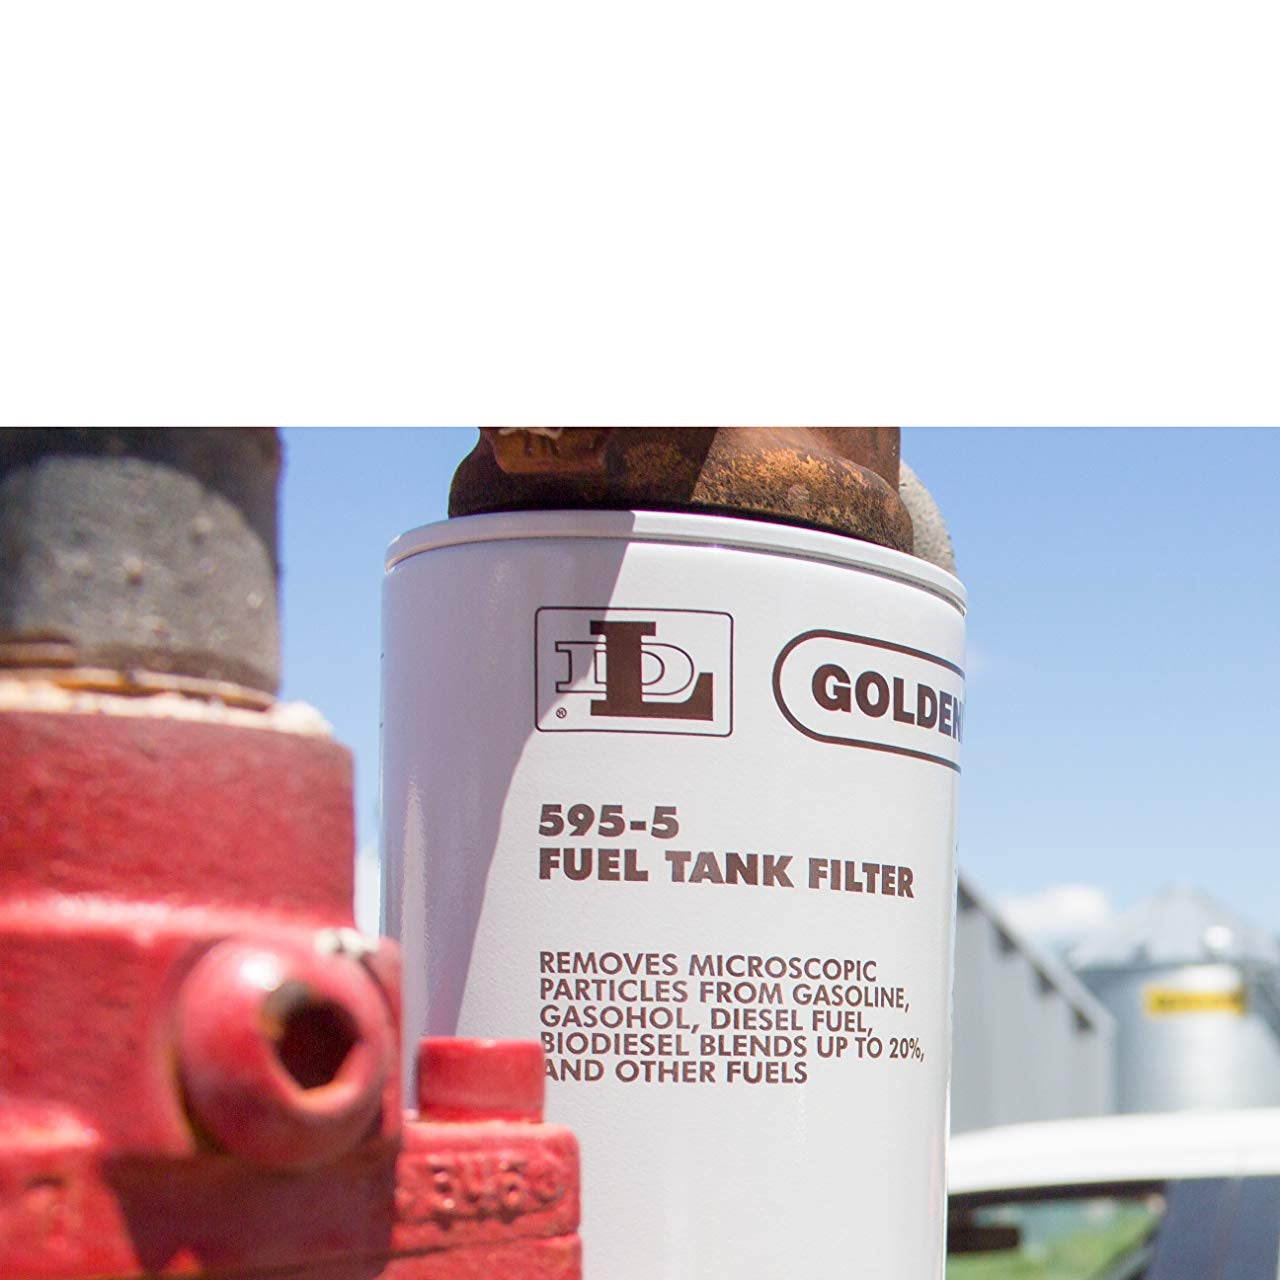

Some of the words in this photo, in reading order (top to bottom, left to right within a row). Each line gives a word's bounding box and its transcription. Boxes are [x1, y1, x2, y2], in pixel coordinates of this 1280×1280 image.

[538, 804, 680, 839] 595-5
[538, 847, 649, 882] FUEL
[665, 850, 794, 889] TANK
[808, 857, 915, 899] FILTER
[539, 951, 678, 976] REMOVES
[689, 954, 877, 982] MICROSCOPIC
[540, 978, 689, 1002] PARTICLES
[700, 981, 783, 1005] FROM
[792, 983, 910, 1013] GASOLINE,
[539, 1004, 700, 1034] GASOHOL,
[710, 1008, 804, 1031] DIESEL
[812, 1010, 873, 1037] FUEL,
[540, 1031, 690, 1056] BIODIESEL
[700, 1034, 808, 1058] BLENDS
[817, 1035, 848, 1058] UP
[855, 1036, 884, 1059] TO
[889, 1037, 925, 1063] 20%,
[544, 1058, 605, 1082] AND
[615, 1059, 717, 1083] OTHER
[726, 1060, 808, 1084] FUELS
